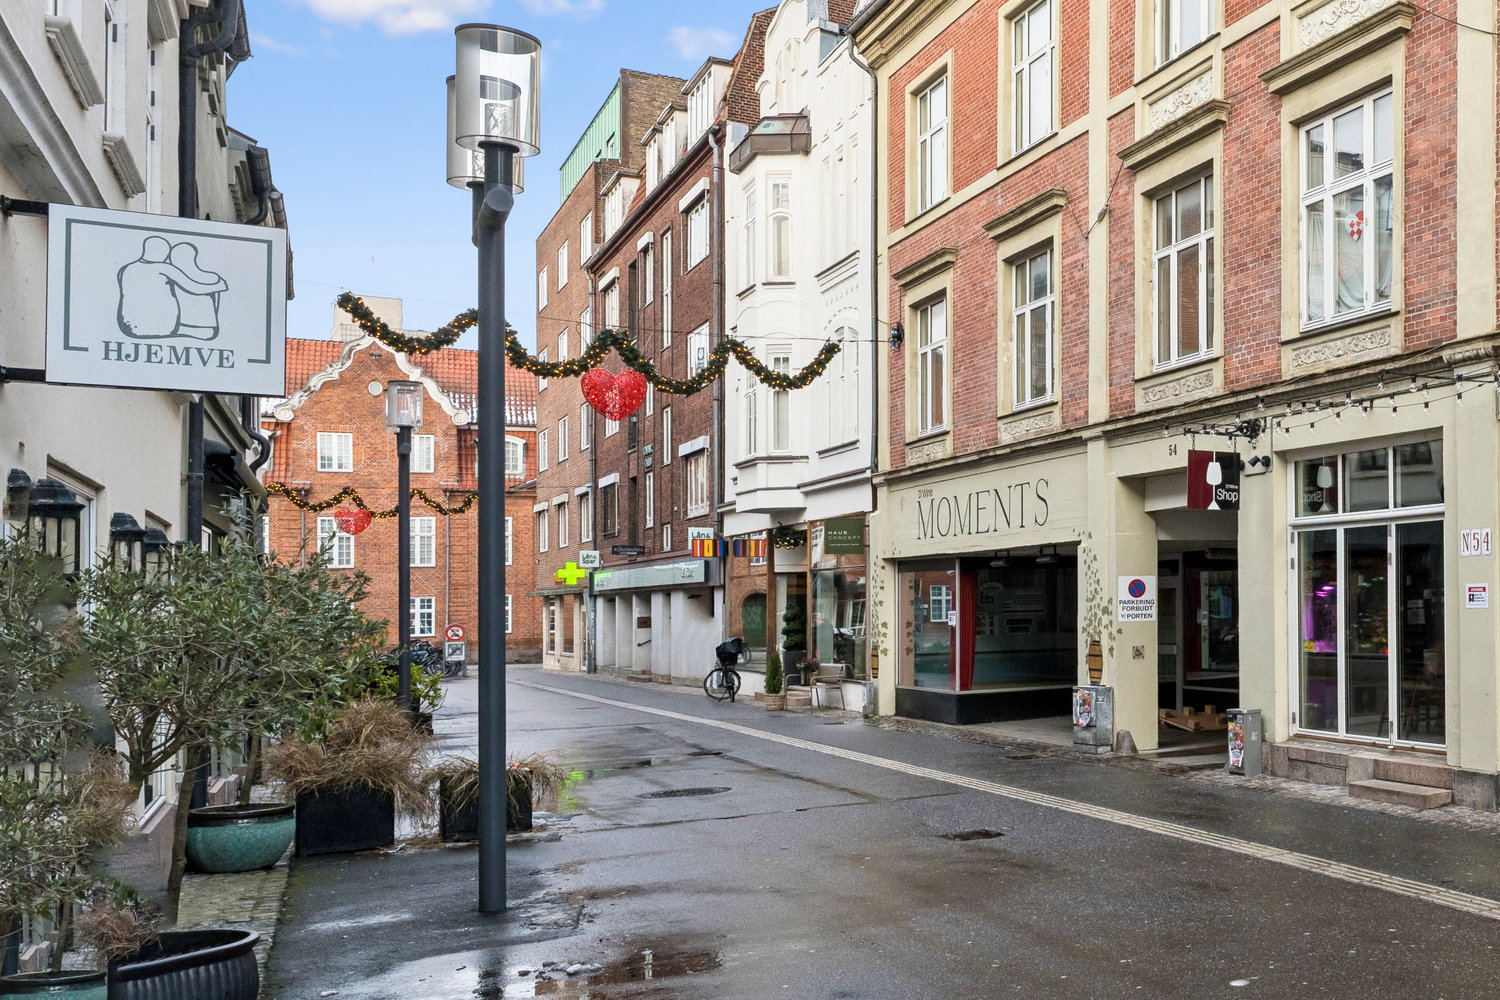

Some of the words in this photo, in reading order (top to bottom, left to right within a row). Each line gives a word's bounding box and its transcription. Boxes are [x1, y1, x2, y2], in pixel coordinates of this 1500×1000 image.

[101, 340, 235, 369] HJEMVE
[1168, 443, 1177, 456] 54
[1216, 488, 1239, 503] Shop
[917, 478, 1049, 540] MOMENTS
[691, 530, 706, 539] Lån
